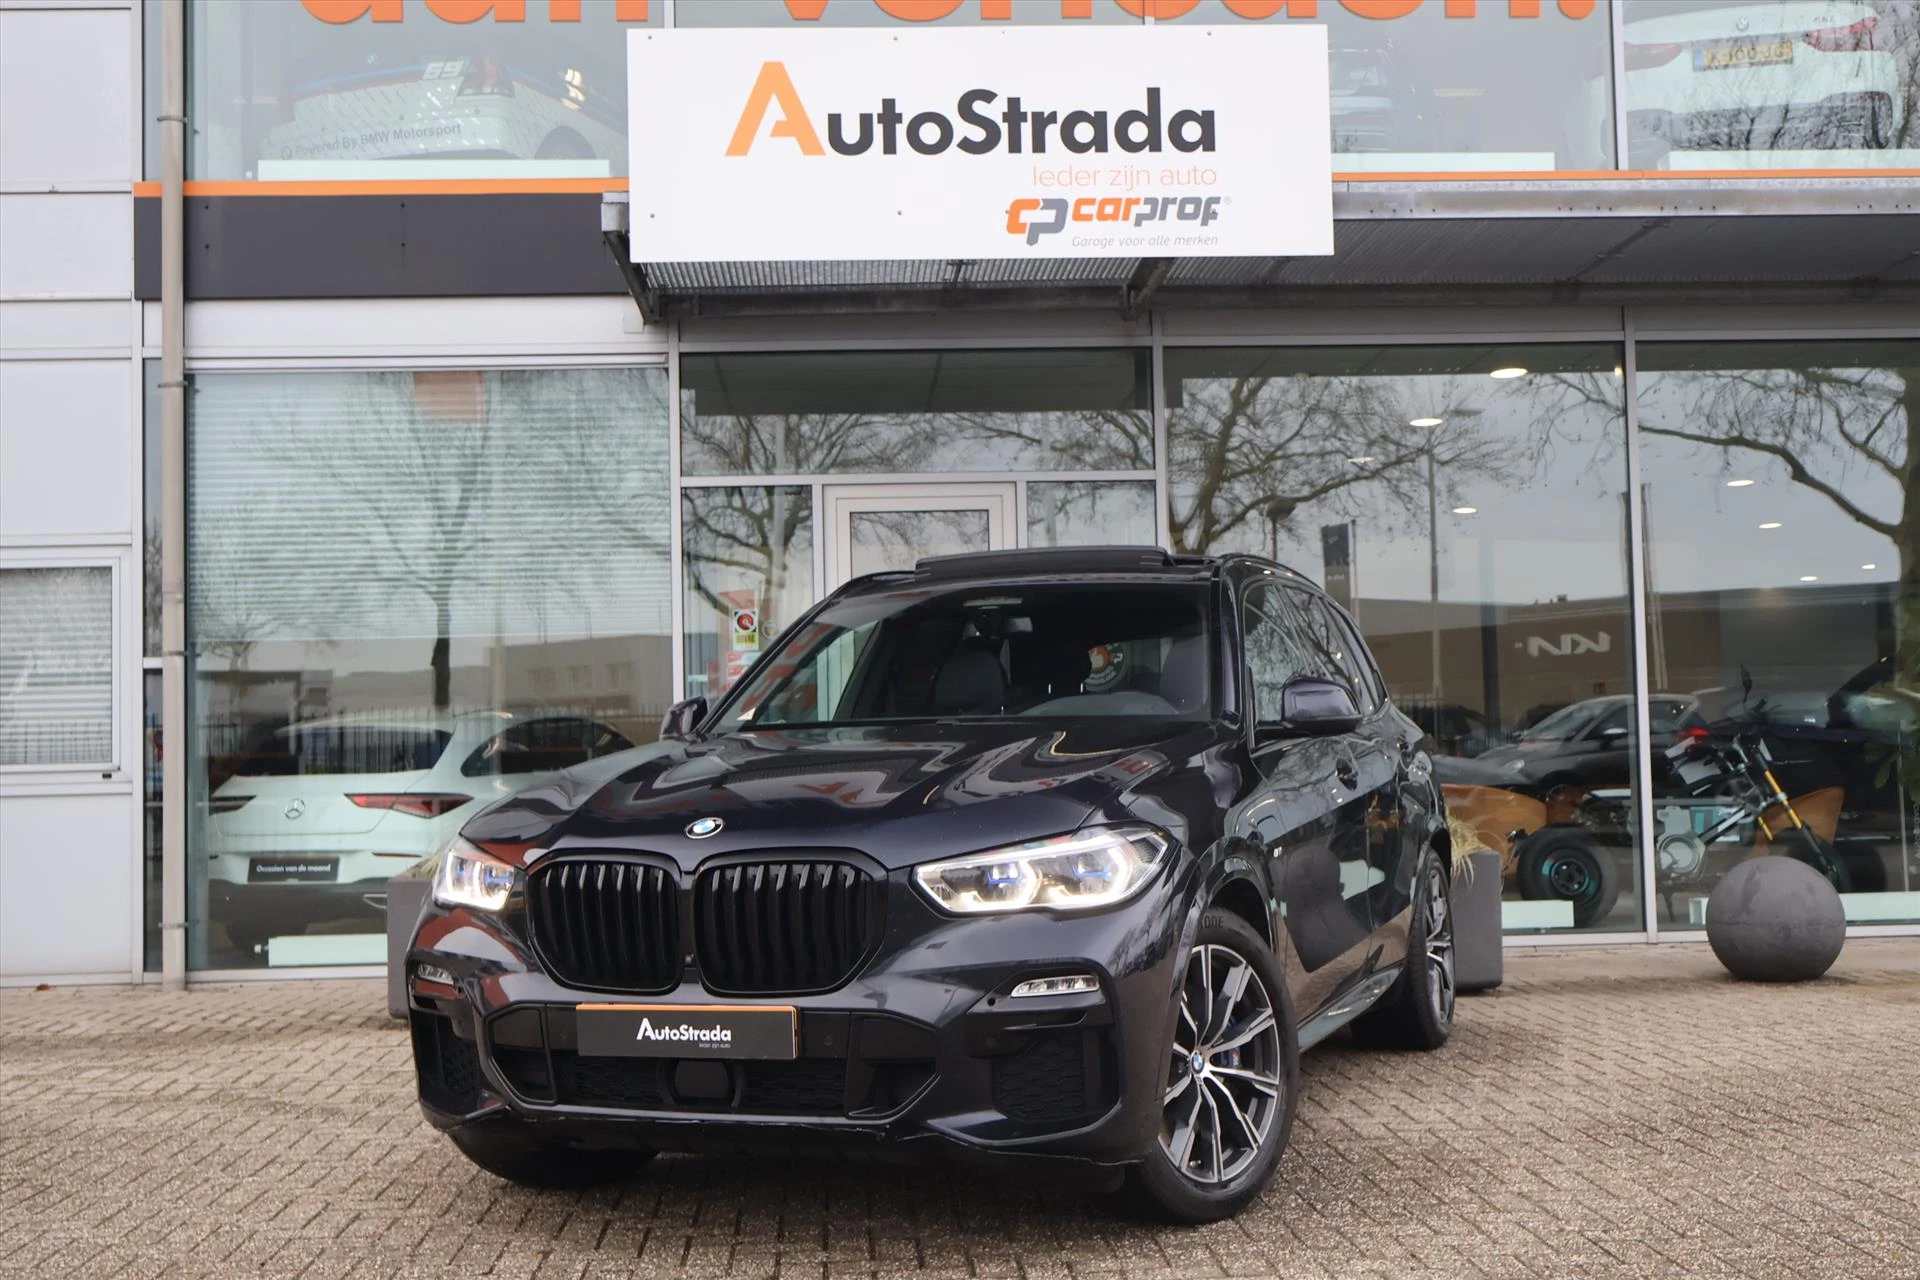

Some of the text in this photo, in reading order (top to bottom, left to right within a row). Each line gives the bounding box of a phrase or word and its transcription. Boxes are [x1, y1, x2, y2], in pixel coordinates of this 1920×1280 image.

[724, 60, 1217, 157] AutoStrada
[342, 136, 358, 150] By
[360, 130, 390, 145] BMW
[393, 123, 462, 140] Motorsport
[1033, 165, 1217, 191] Ieder zijn auto
[1072, 234, 1218, 249] Garage voor alle merken
[636, 1017, 732, 1041] AutoStrada
